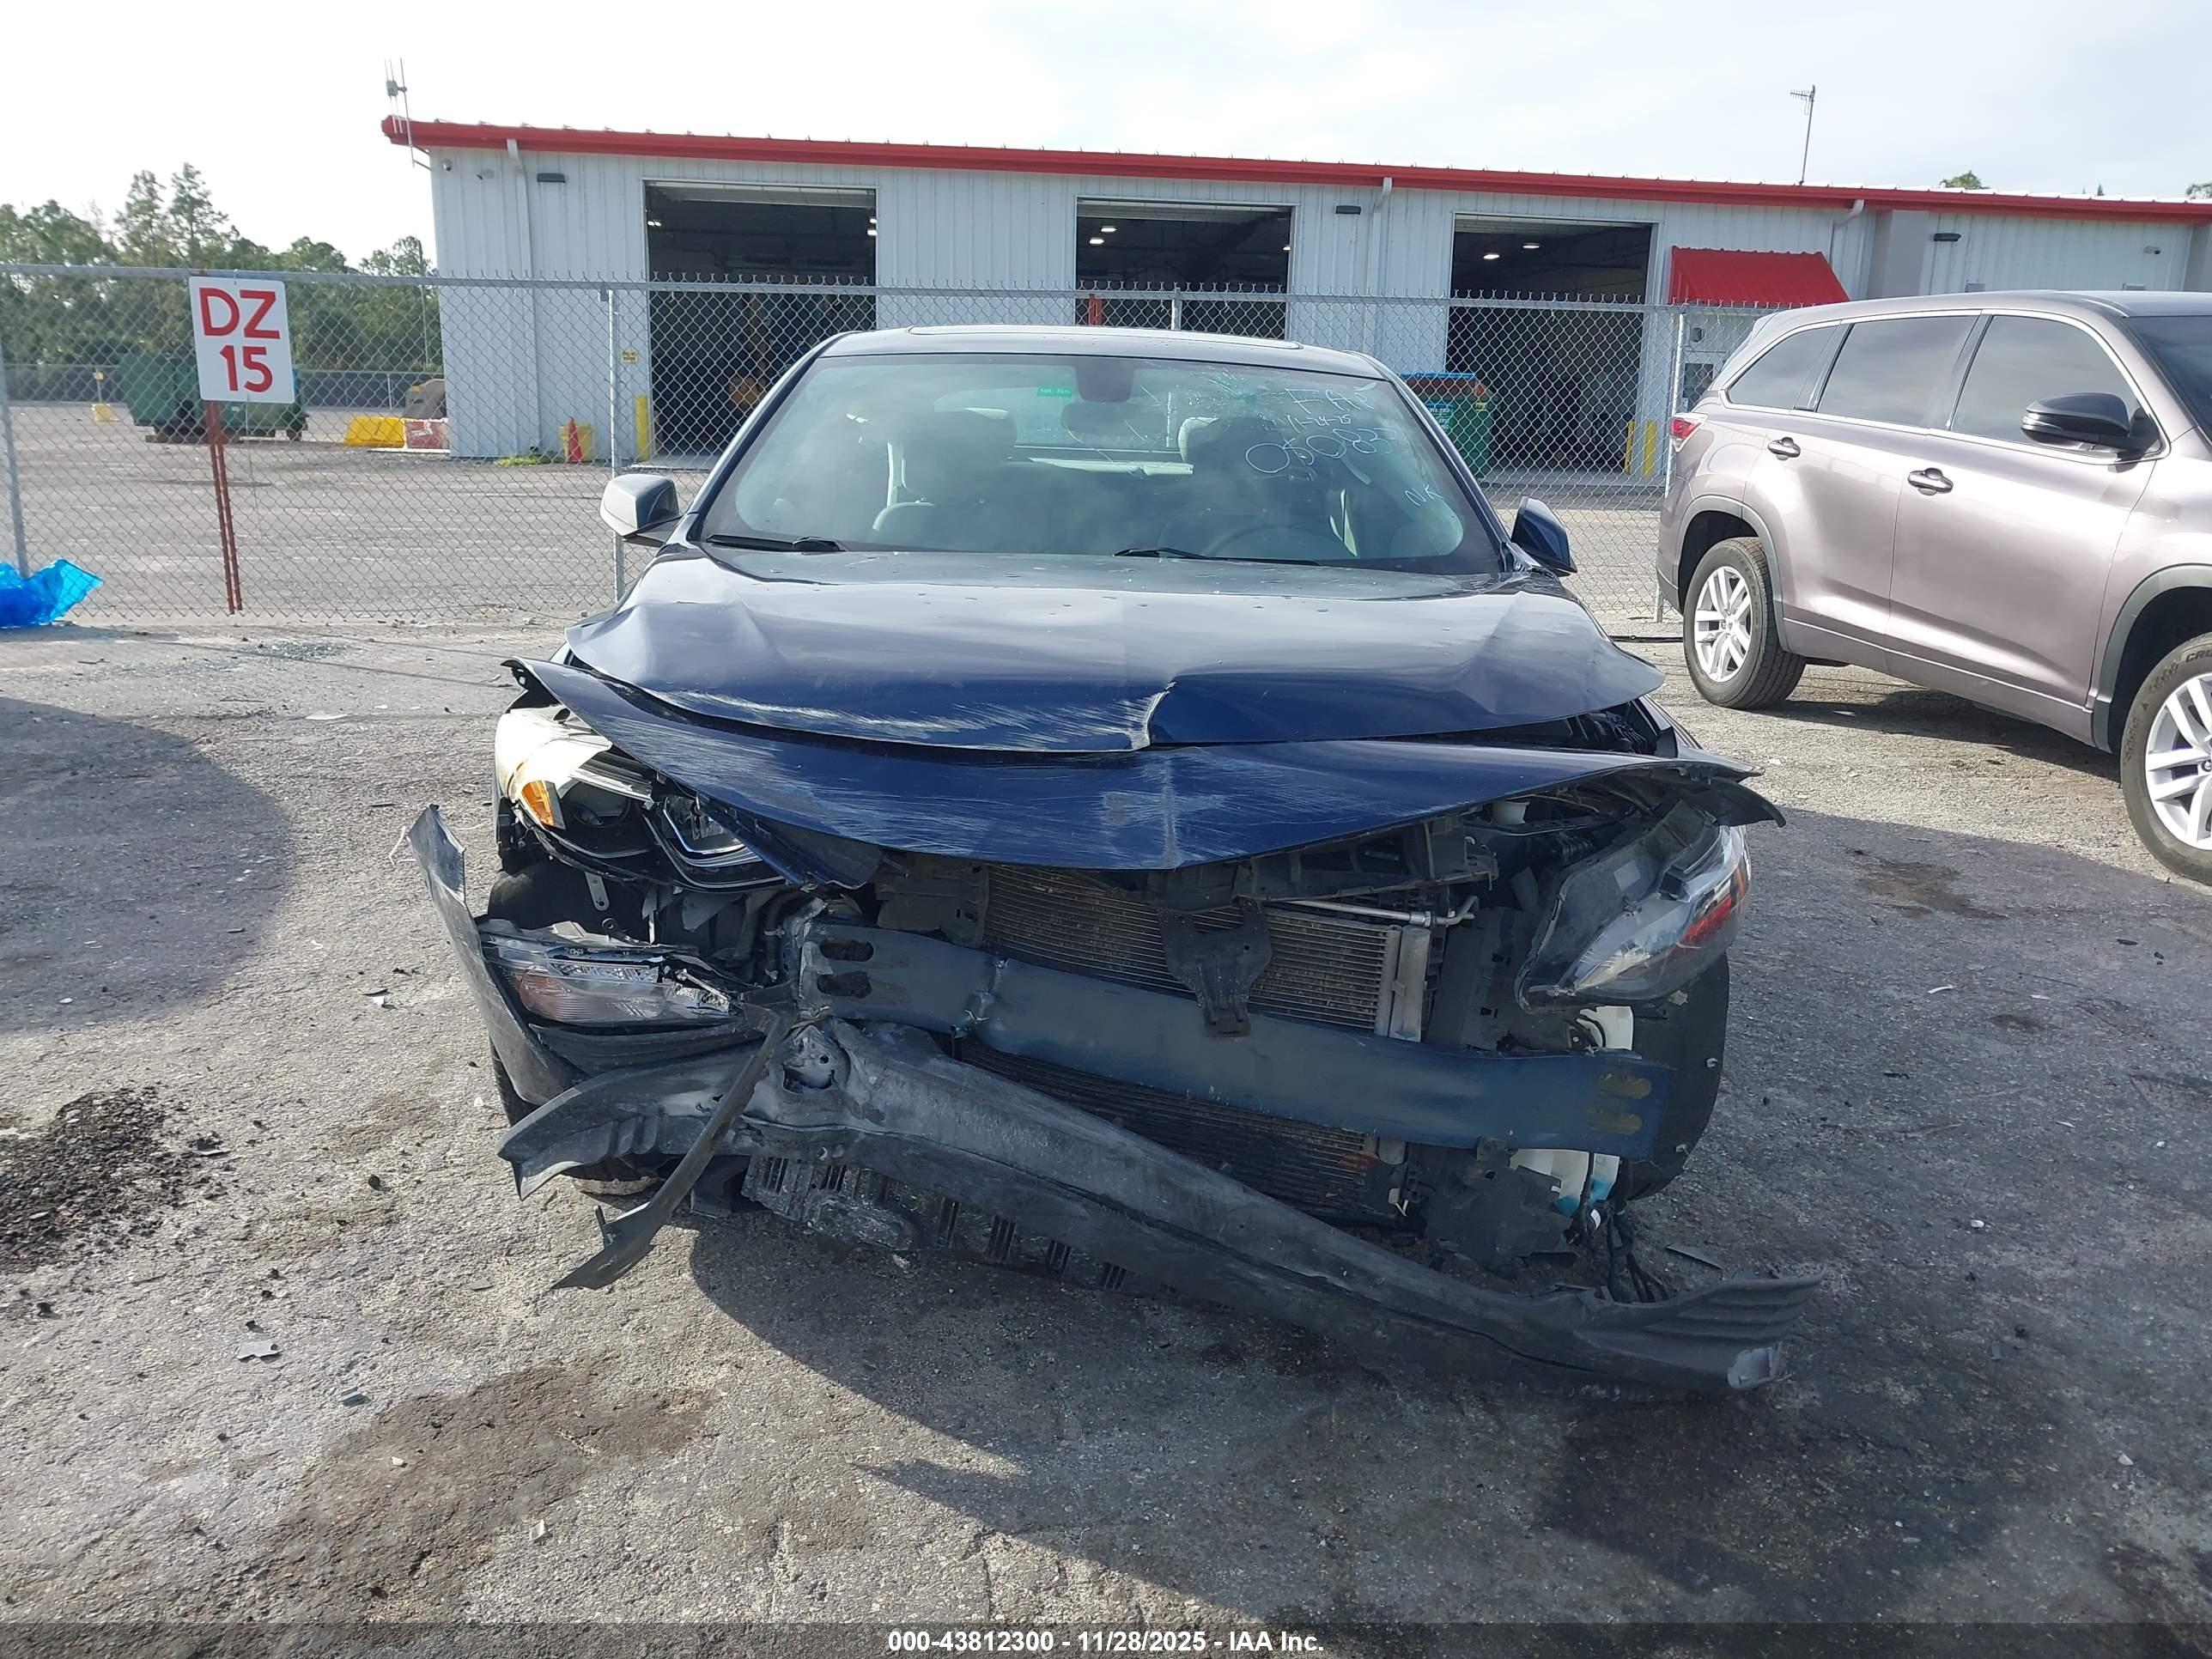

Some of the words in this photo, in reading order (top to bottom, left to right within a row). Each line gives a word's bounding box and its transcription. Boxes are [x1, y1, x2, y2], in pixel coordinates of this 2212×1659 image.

[198, 287, 281, 340] DZ
[219, 344, 273, 393] 15
[1404, 483, 1444, 507] NK
